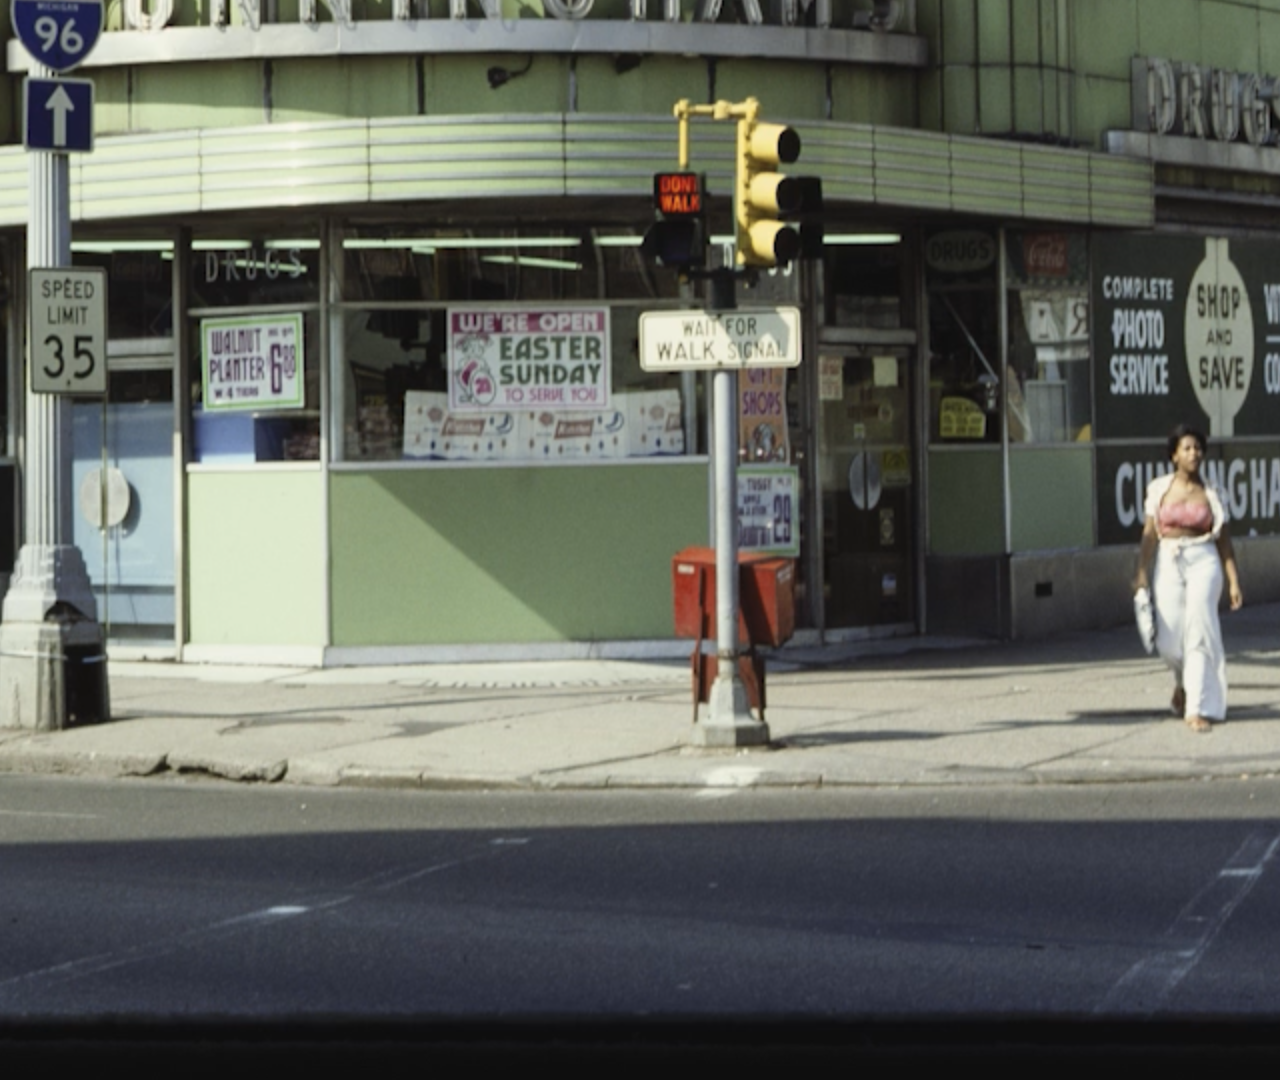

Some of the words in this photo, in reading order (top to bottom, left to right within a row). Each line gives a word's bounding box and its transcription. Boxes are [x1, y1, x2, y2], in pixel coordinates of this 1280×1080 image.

[34, 17, 84, 55] 96
[660, 194, 701, 213] WALK
[931, 238, 990, 262] DRUGS
[205, 248, 302, 282] DRUGS
[41, 279, 95, 299] SPEED
[1103, 276, 1174, 300] COMPLETE
[1197, 285, 1240, 319] SHOP
[48, 307, 89, 325] LIMIT
[459, 313, 528, 331] WE'RE
[539, 313, 598, 331] OPEN
[683, 319, 718, 338] WAIT
[726, 318, 757, 337] FOR
[1111, 309, 1164, 349] PHOTO
[1206, 329, 1232, 346] AND
[211, 328, 262, 355] WALNUT
[499, 336, 601, 360] EASTER
[656, 342, 714, 361] WALK
[727, 340, 786, 360] SIGNAL
[43, 334, 95, 379] 35
[209, 357, 265, 383] PLANTER
[499, 364, 602, 385] SUNDAY
[1110, 355, 1169, 395] SERVICE
[1199, 357, 1244, 390] SAVE
[505, 389, 523, 402] TO
[529, 388, 564, 402] SERVE
[571, 388, 597, 402] YOU
[743, 391, 782, 415] SHOPS
